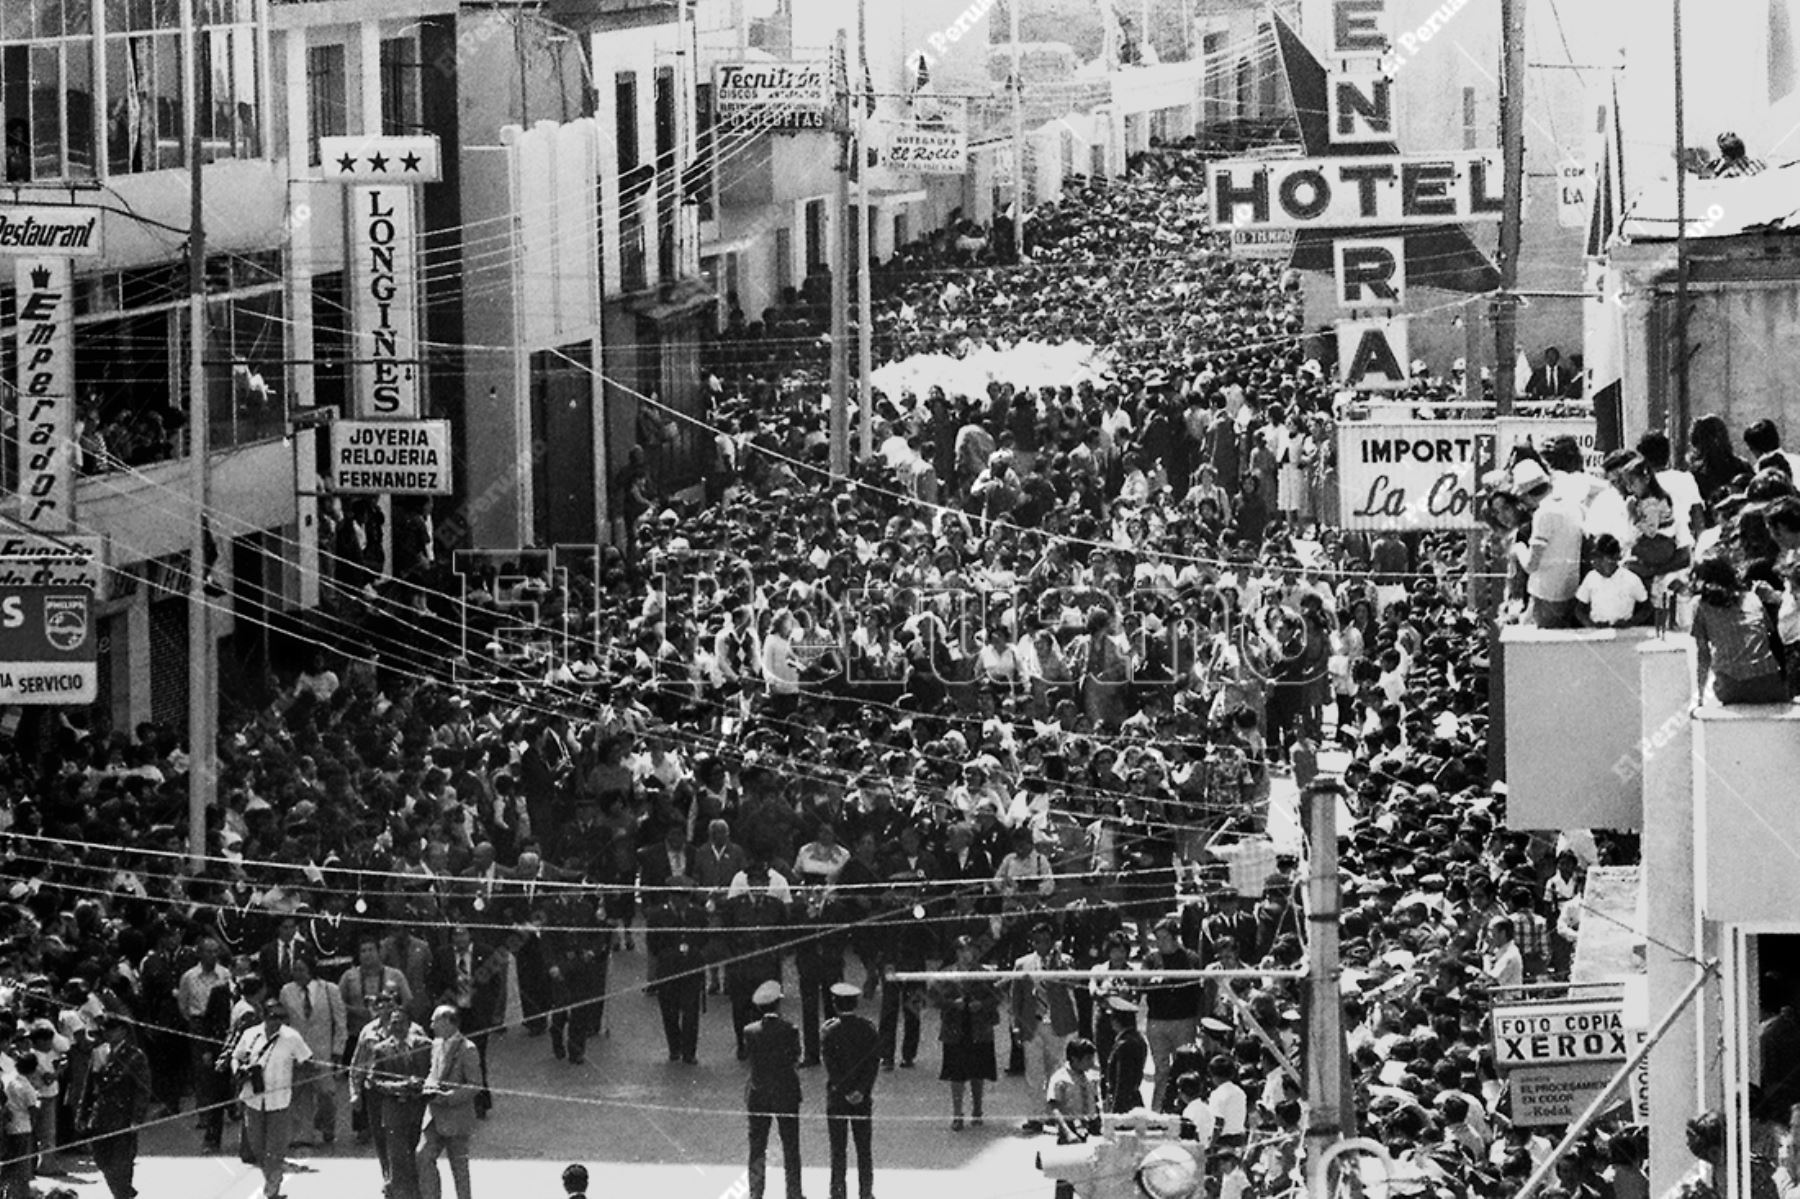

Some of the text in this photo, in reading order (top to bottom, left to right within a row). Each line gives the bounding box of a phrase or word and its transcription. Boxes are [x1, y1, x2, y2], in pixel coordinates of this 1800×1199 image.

[1216, 159, 1503, 223] HOTEL
[369, 191, 400, 413] LONGINES
[19, 292, 63, 521] Emperador
[349, 428, 429, 446] JOYERIA
[341, 448, 438, 466] RELOJERIA
[1361, 438, 1475, 463] IMPORT
[339, 471, 438, 488] FERNANDEZ
[1353, 473, 1475, 517] La Co
[19, 673, 83, 694] SERVICIO
[1502, 1012, 1623, 1035] FOTO COPIA
[1505, 1033, 1626, 1061] XEROX
[1533, 1105, 1572, 1117] Kodak
